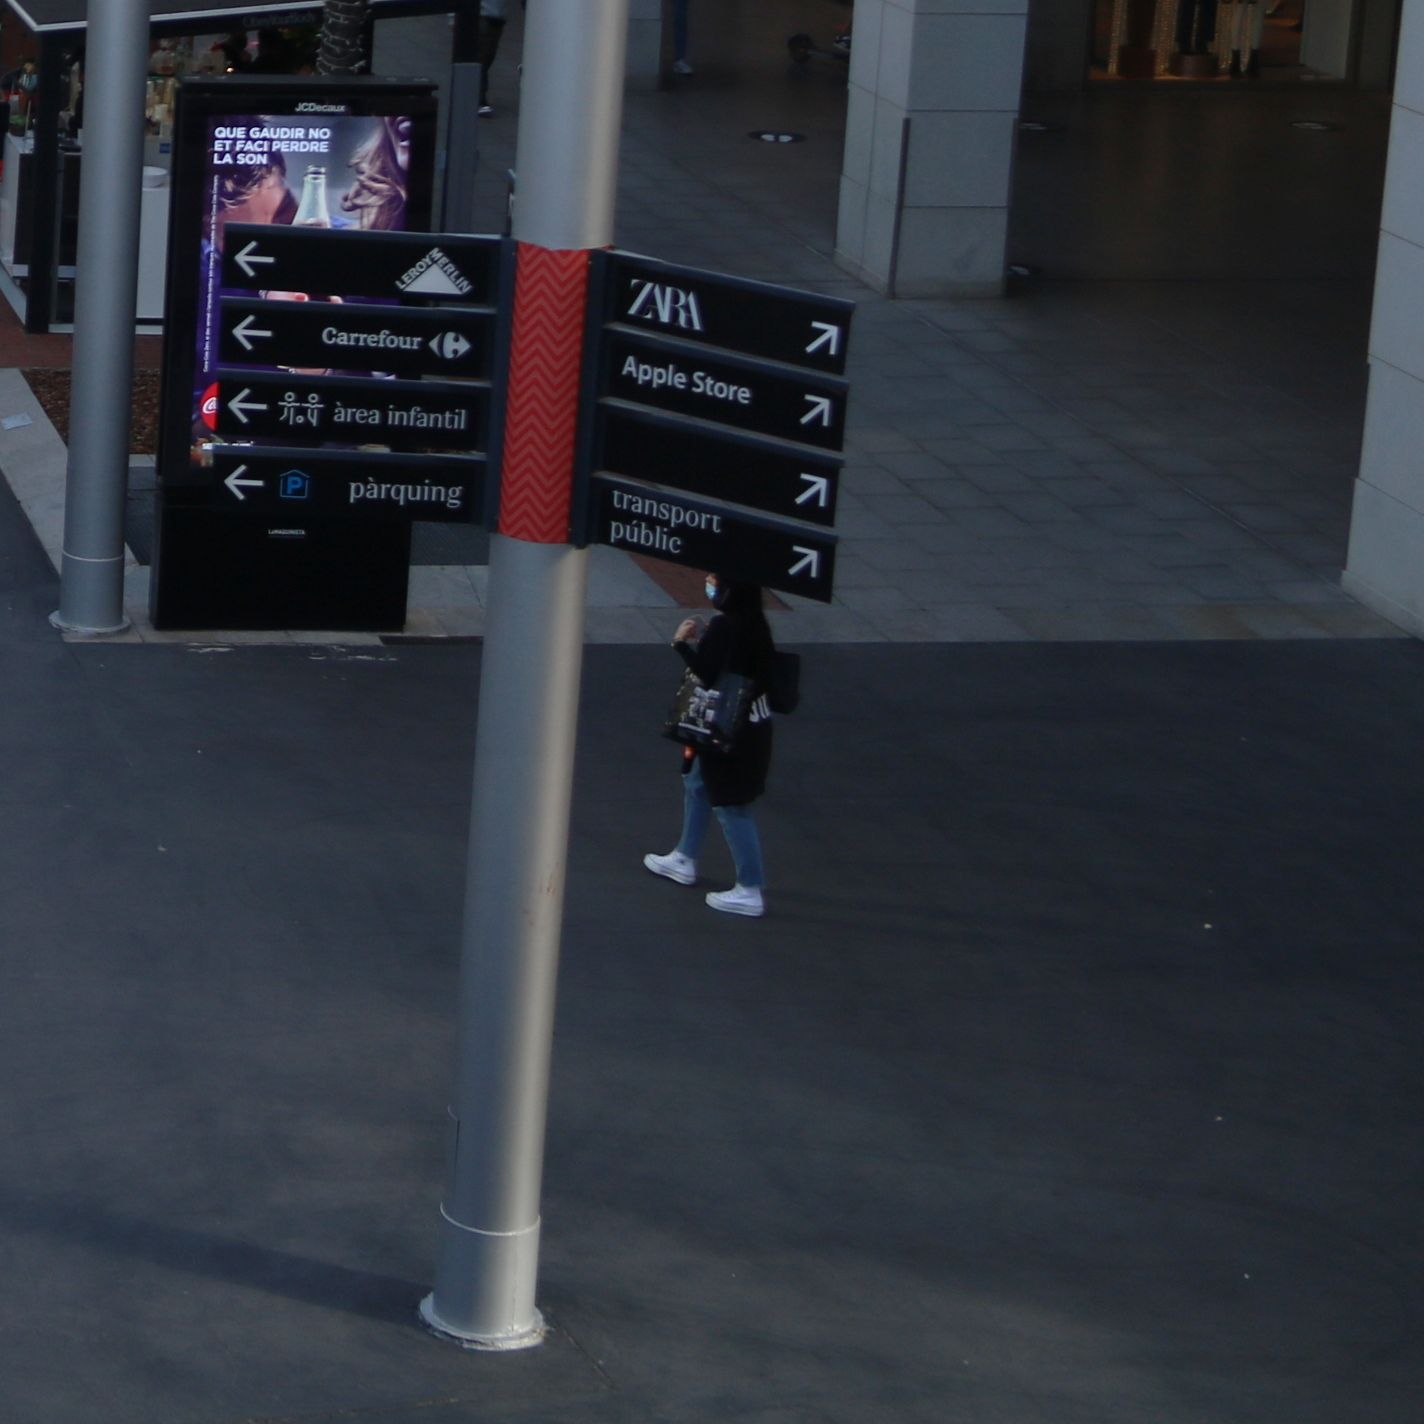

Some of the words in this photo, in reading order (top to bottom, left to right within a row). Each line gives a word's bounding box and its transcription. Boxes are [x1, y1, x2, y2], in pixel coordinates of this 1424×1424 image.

[294, 102, 346, 113] JCDecaux
[213, 139, 232, 152] ET
[235, 140, 269, 152] FACI
[271, 140, 330, 153] PERDRE
[214, 126, 247, 139] QUE
[249, 127, 305, 139] GAUDIR
[308, 128, 331, 139] NO
[212, 152, 233, 165] LA
[236, 153, 269, 165] SON
[394, 255, 434, 291] LEROY
[428, 247, 473, 295] MERLIN
[627, 278, 704, 331] ZARA
[321, 326, 423, 350] Carrefour
[621, 355, 687, 389] Apple
[691, 371, 753, 404] Store
[333, 401, 381, 424] àrea
[387, 404, 468, 430] infantil
[287, 476, 302, 494] P
[348, 476, 464, 508] pàrquing
[611, 488, 722, 534] transport
[609, 519, 683, 554] públic
